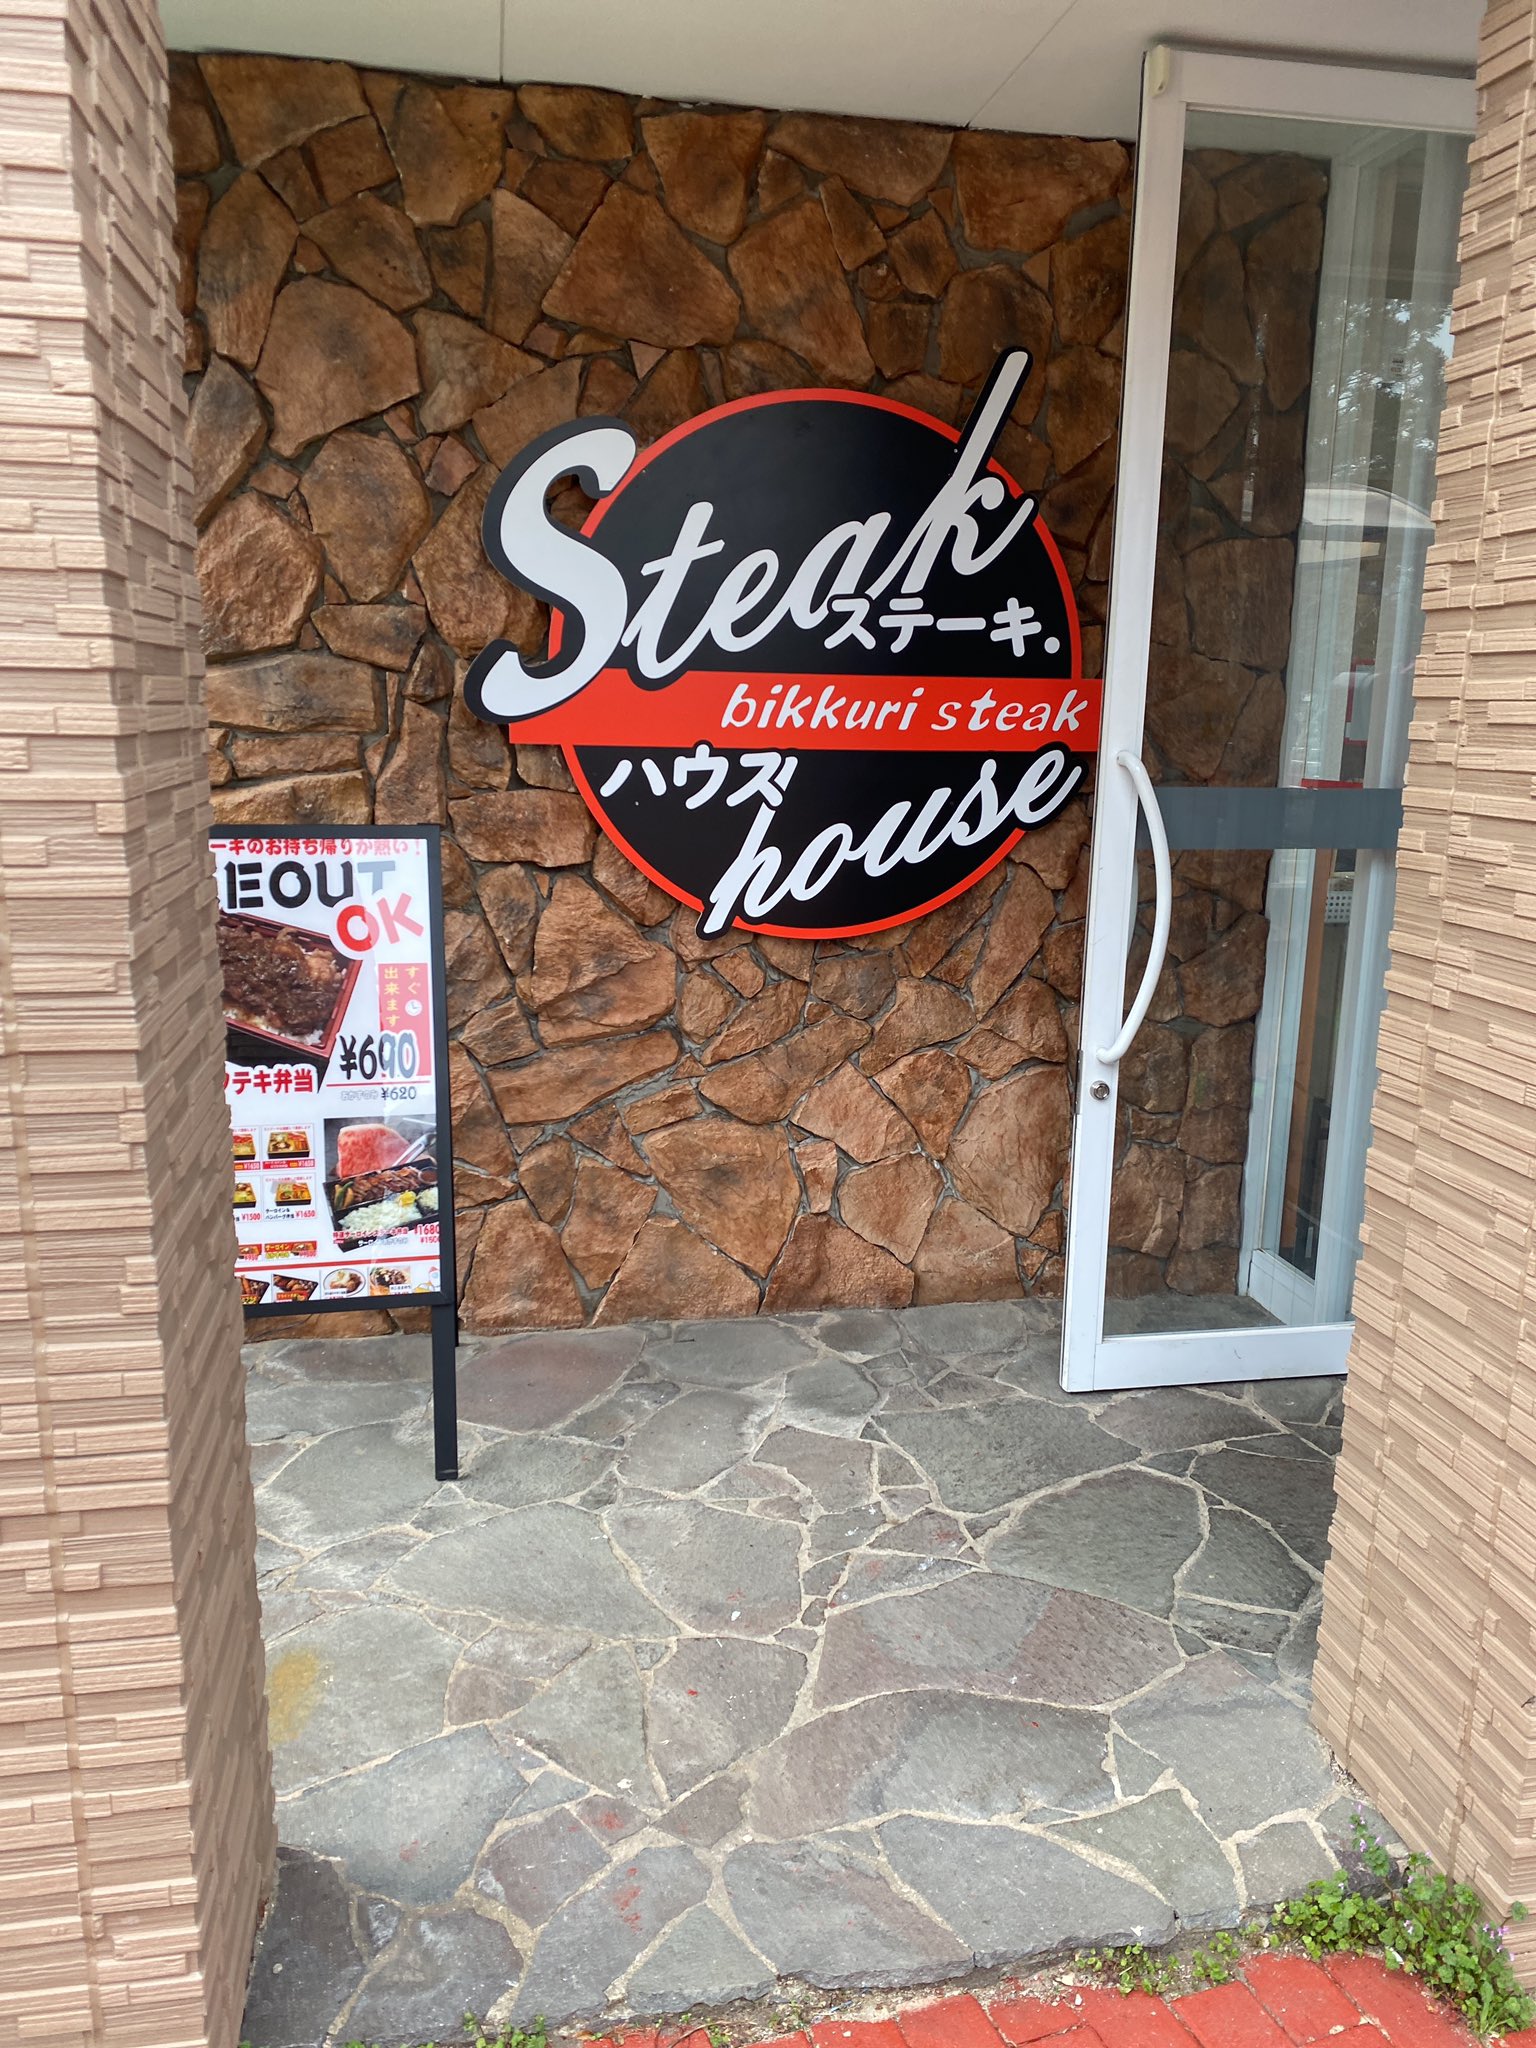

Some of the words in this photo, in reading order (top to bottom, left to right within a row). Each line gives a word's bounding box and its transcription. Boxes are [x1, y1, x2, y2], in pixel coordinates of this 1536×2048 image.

[480, 350, 1035, 717] Steak
[721, 683, 925, 730] bikkuri
[930, 688, 1088, 732] steak
[703, 749, 1083, 933] house
[336, 893, 424, 952] OK
[383, 966, 400, 1027] 出来ます
[339, 1033, 416, 1080] ¥690
[381, 1086, 417, 1101] ¥620
